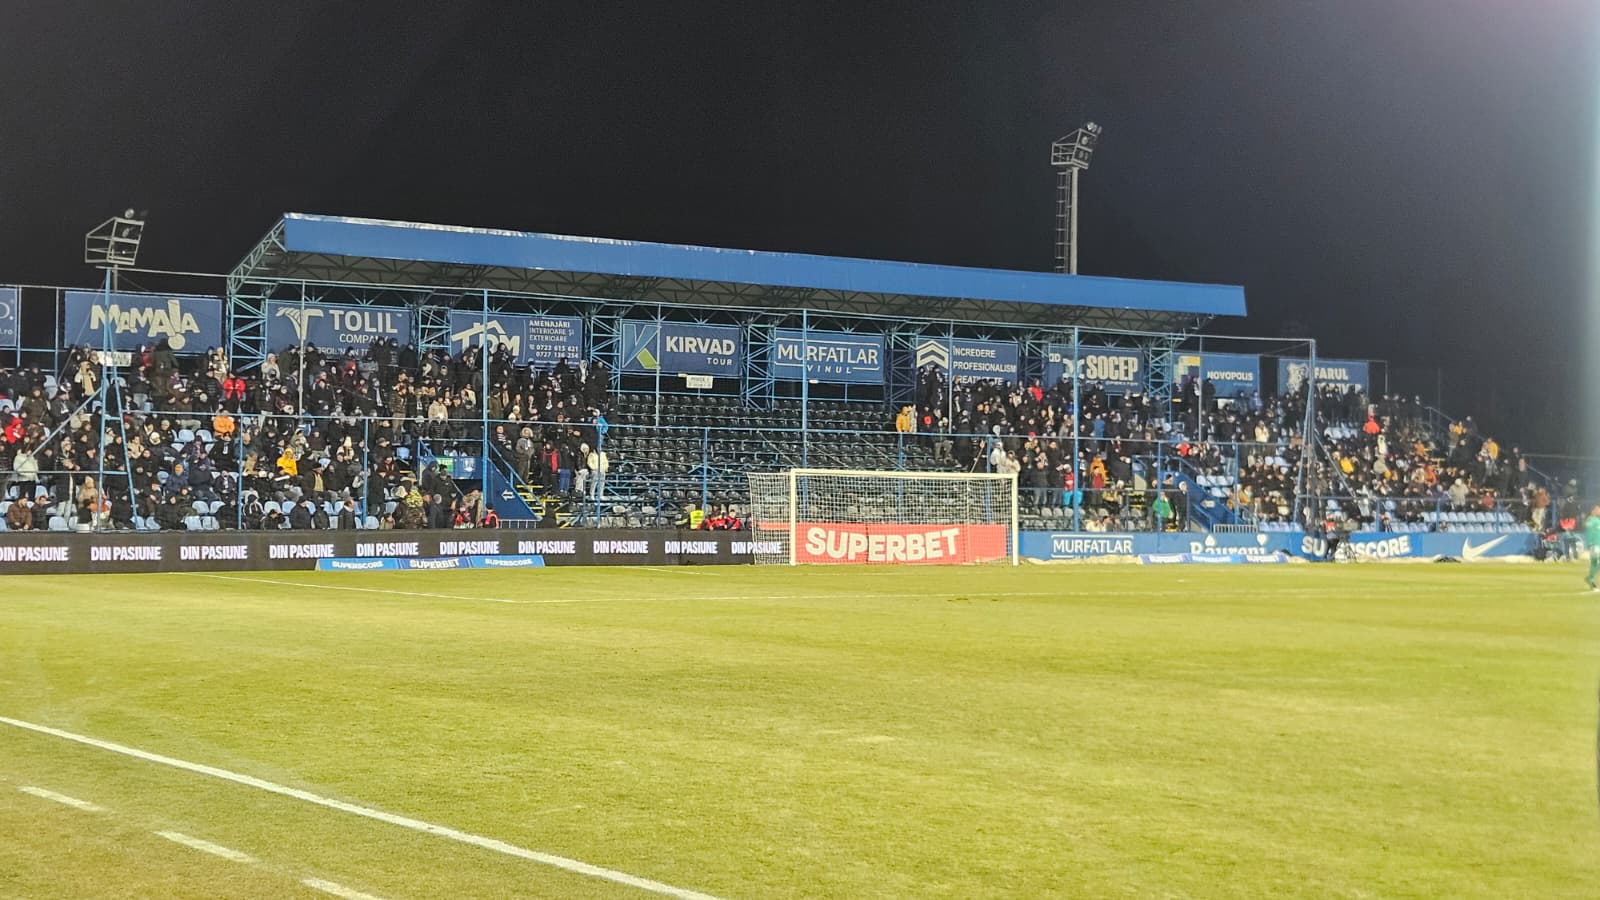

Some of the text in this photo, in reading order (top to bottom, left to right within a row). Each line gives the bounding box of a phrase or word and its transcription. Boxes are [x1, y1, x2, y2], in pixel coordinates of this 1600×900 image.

[329, 310, 398, 333] TOLIL
[339, 333, 388, 344] COMPA
[666, 335, 736, 356] KIRVAD
[778, 344, 878, 364] MURFATLAR
[707, 357, 733, 366] TOUR
[953, 361, 1017, 373] PROFESIONALISM
[1086, 355, 1138, 381] SOCEP
[807, 365, 852, 374] VINUL
[1207, 371, 1253, 381] NOVOPOLIS
[1314, 367, 1349, 380] FARUL
[269, 544, 334, 558] DIN PASIUNE
[357, 542, 418, 556] DIN PASIUNE
[440, 541, 499, 554] DIN PASIUNE
[519, 541, 575, 553] DIN PASIUNE
[593, 541, 648, 553] DIN PASIUNE
[665, 541, 717, 553] DIN PASIUNE
[731, 541, 782, 553] DIN PASIUNE
[805, 527, 960, 562] SUPERBET
[1053, 539, 1132, 553] MURFATLAR
[1301, 535, 1410, 558] SUSCORE
[18, 547, 69, 561] PASIUNE
[91, 546, 162, 560] DIN PASIUNE
[180, 545, 248, 559] DIN PASIUNE
[409, 558, 460, 569] SUPERBET
